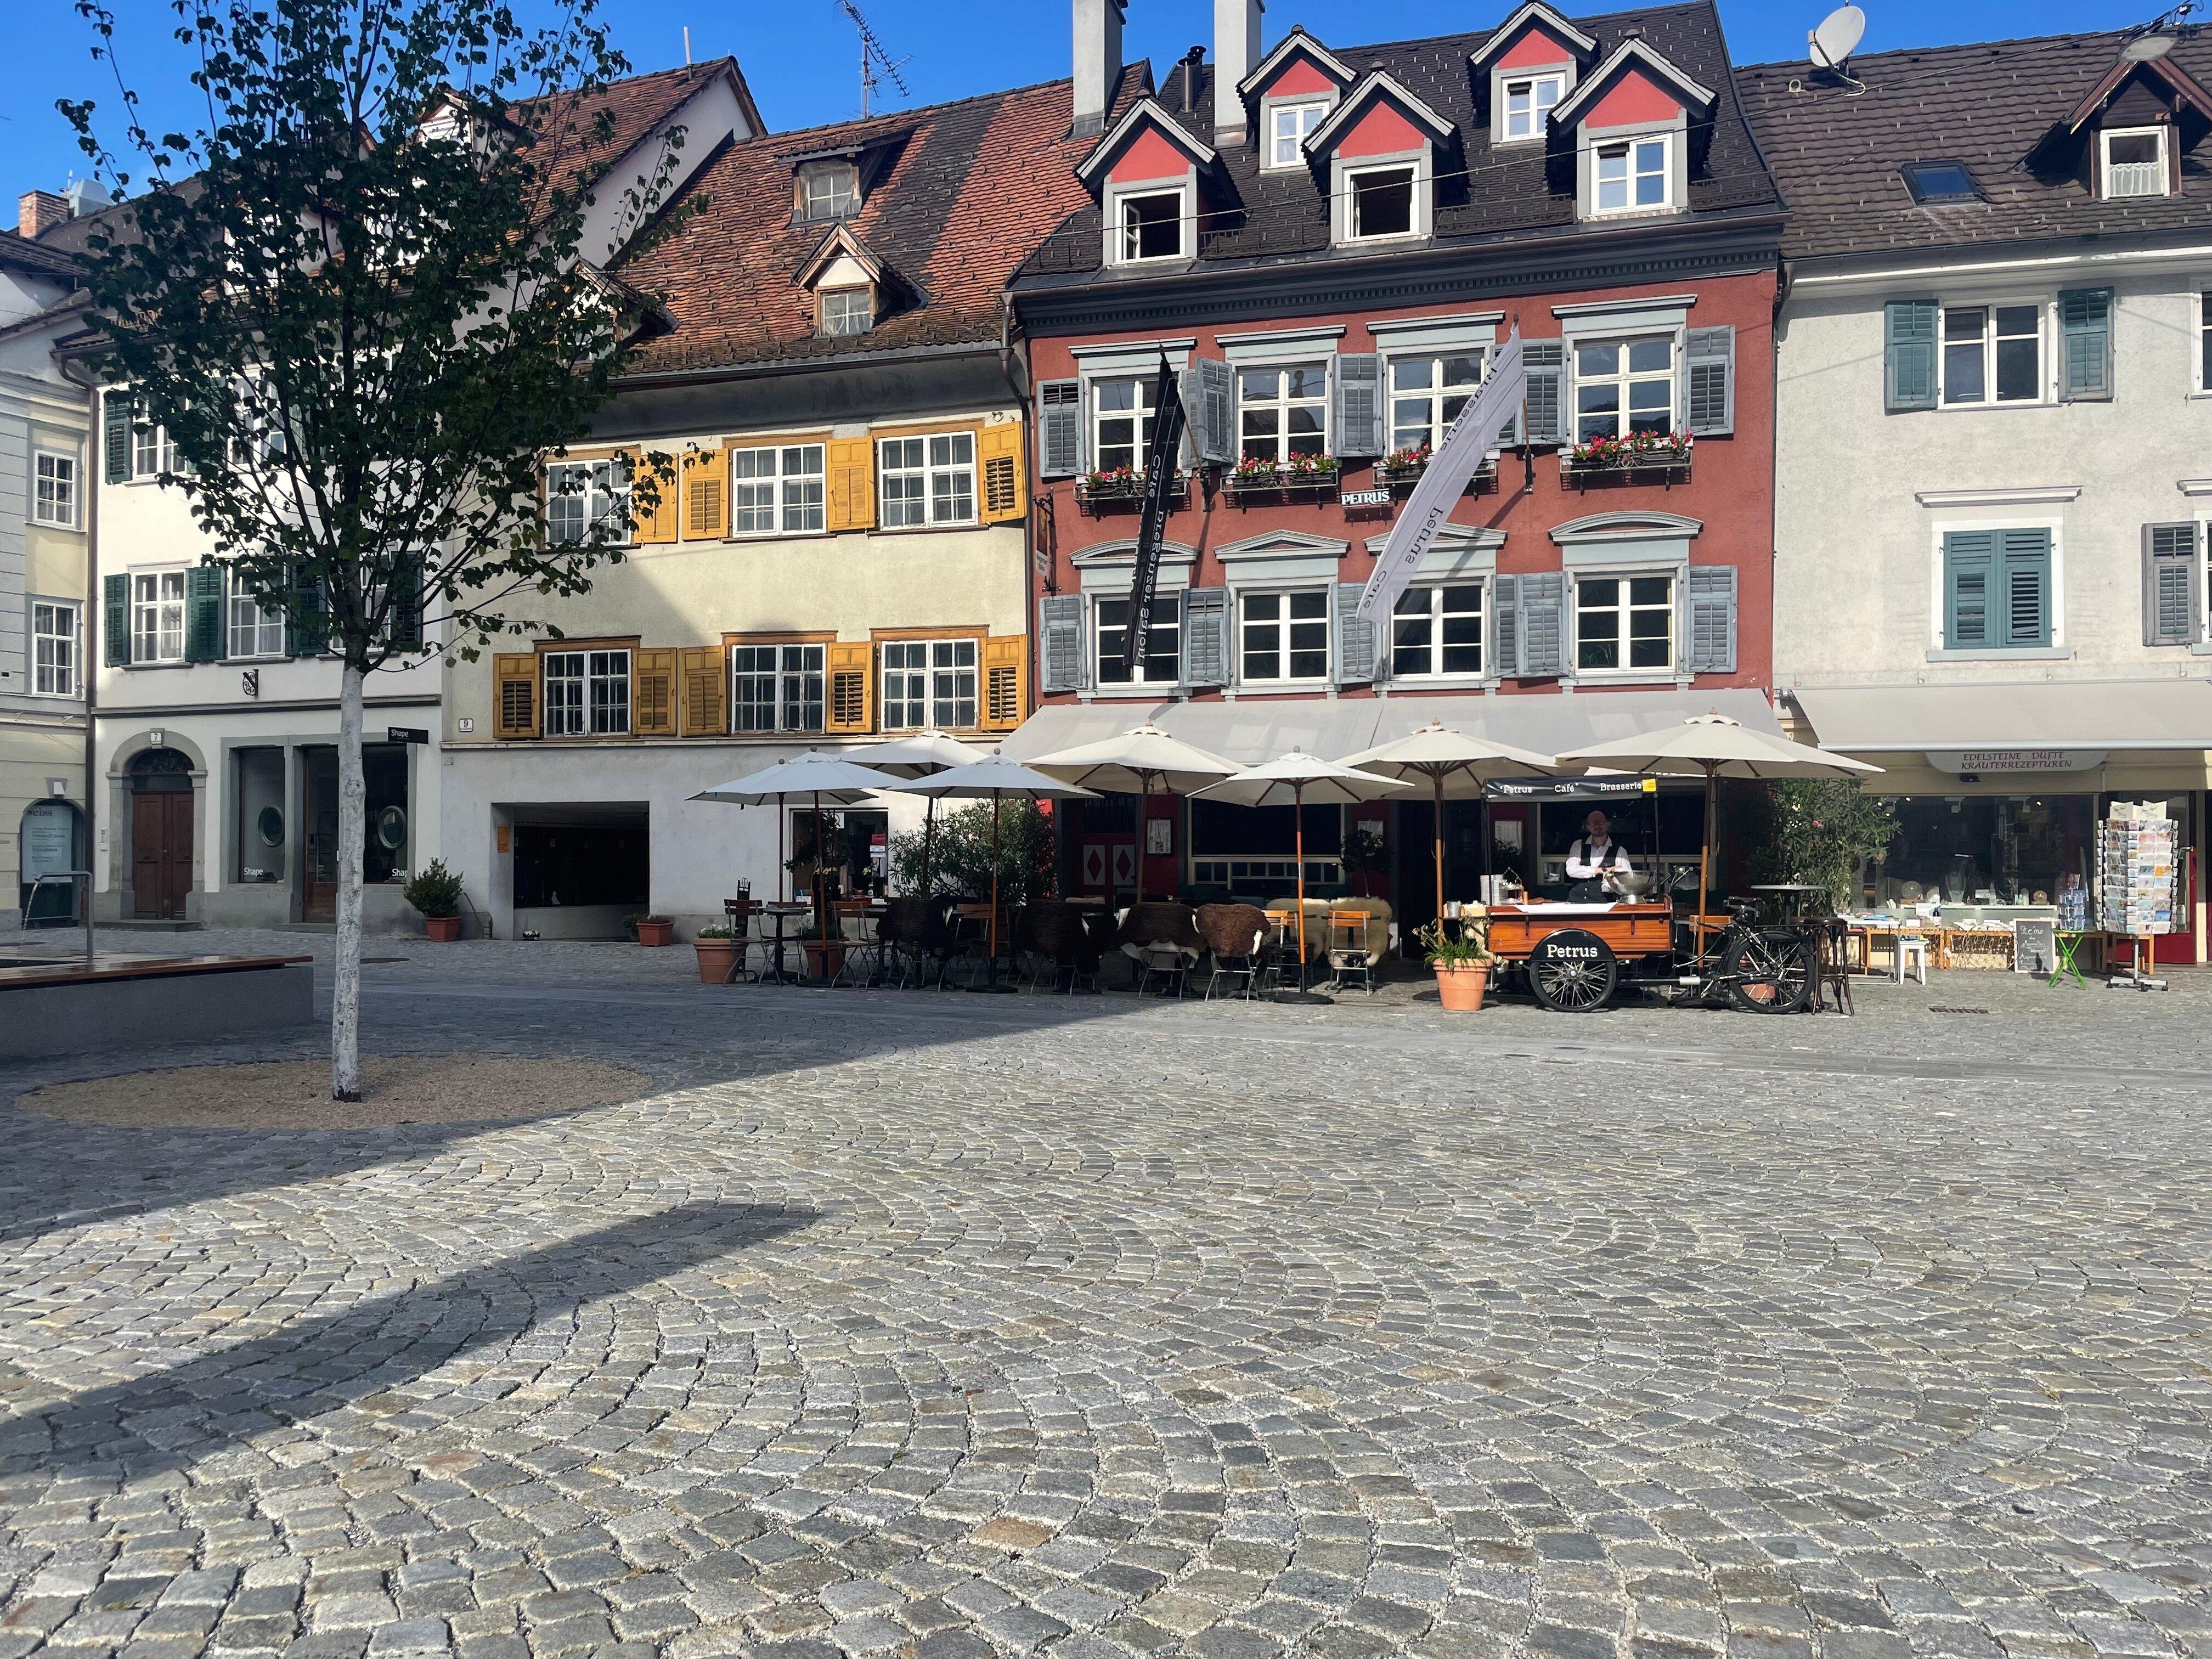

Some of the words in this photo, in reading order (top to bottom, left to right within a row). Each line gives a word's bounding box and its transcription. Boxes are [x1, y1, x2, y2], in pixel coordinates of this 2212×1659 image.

[1341, 491, 1390, 505] PETRUS
[464, 719, 468, 727] 9
[391, 729, 409, 738] Shape
[1964, 753, 2021, 761] EDELSTEINE
[1503, 784, 1532, 793] Petrus
[1600, 781, 1642, 791] Brasserie
[244, 867, 263, 878] Shape
[1547, 944, 1598, 958] Petrus
